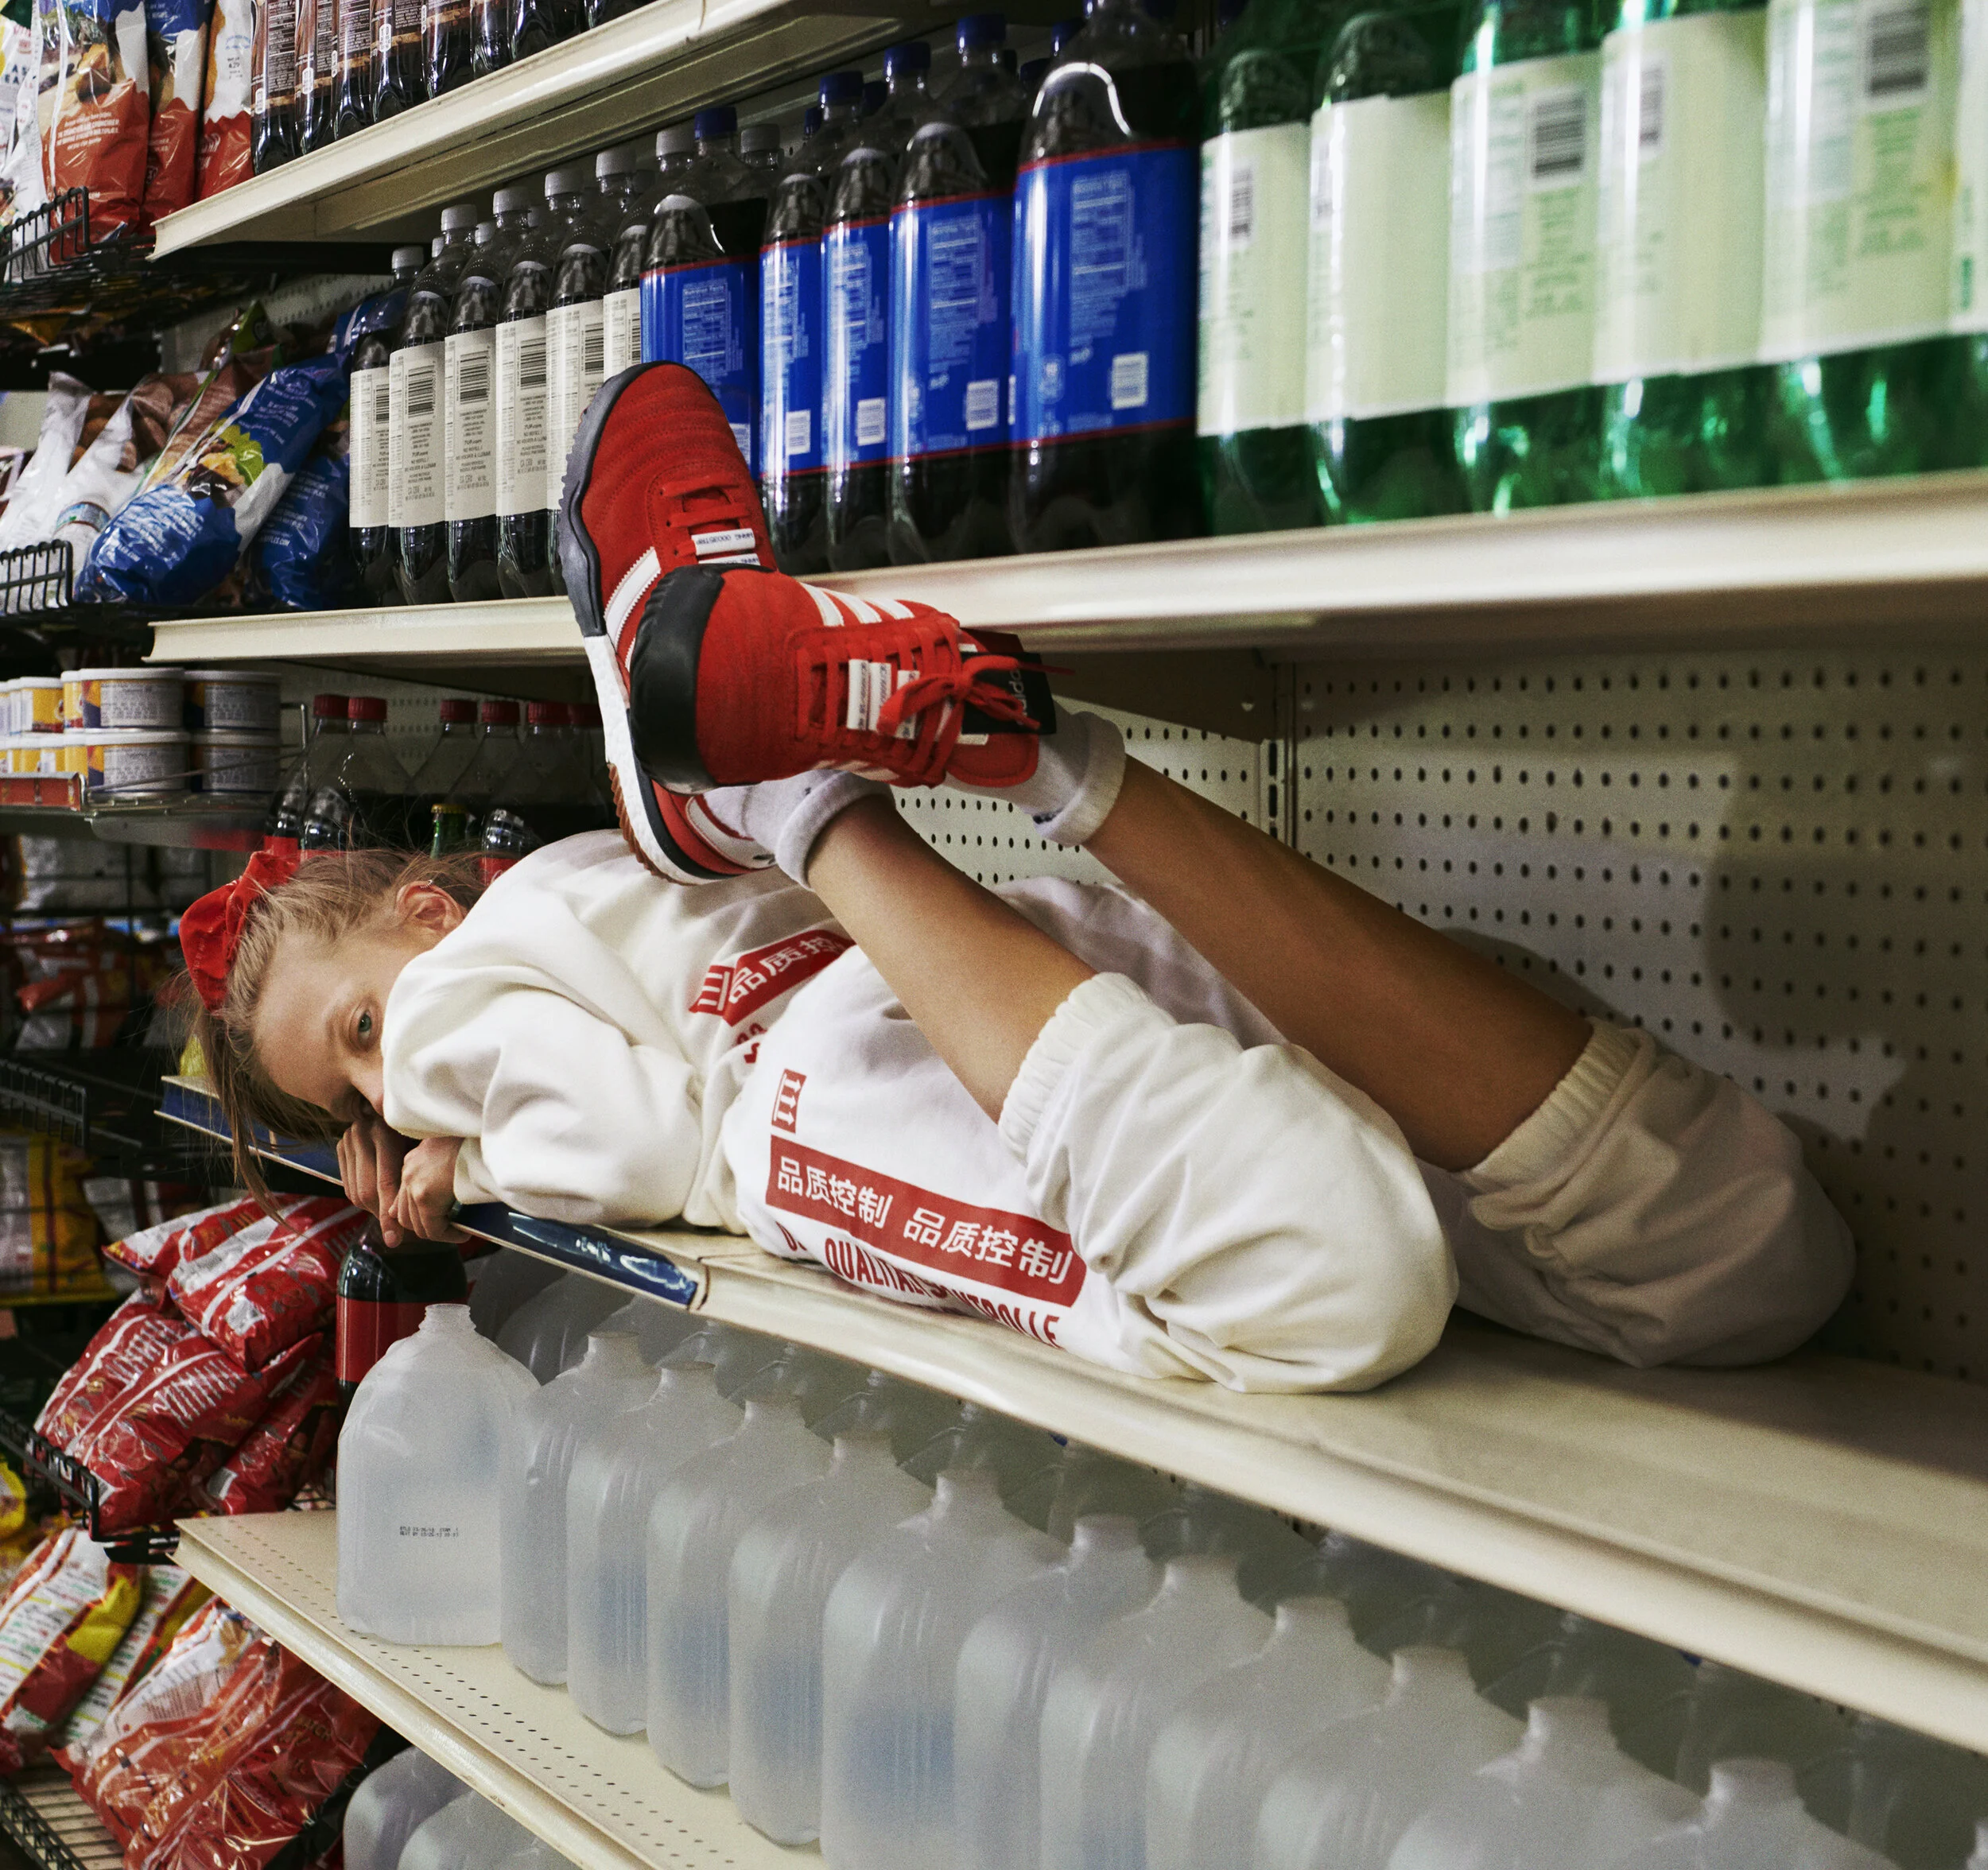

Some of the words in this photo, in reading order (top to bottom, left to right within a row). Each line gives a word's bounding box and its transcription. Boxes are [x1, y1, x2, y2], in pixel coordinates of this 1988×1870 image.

[776, 1156, 893, 1230] 品质控制
[903, 1206, 1074, 1285] 品质控制
